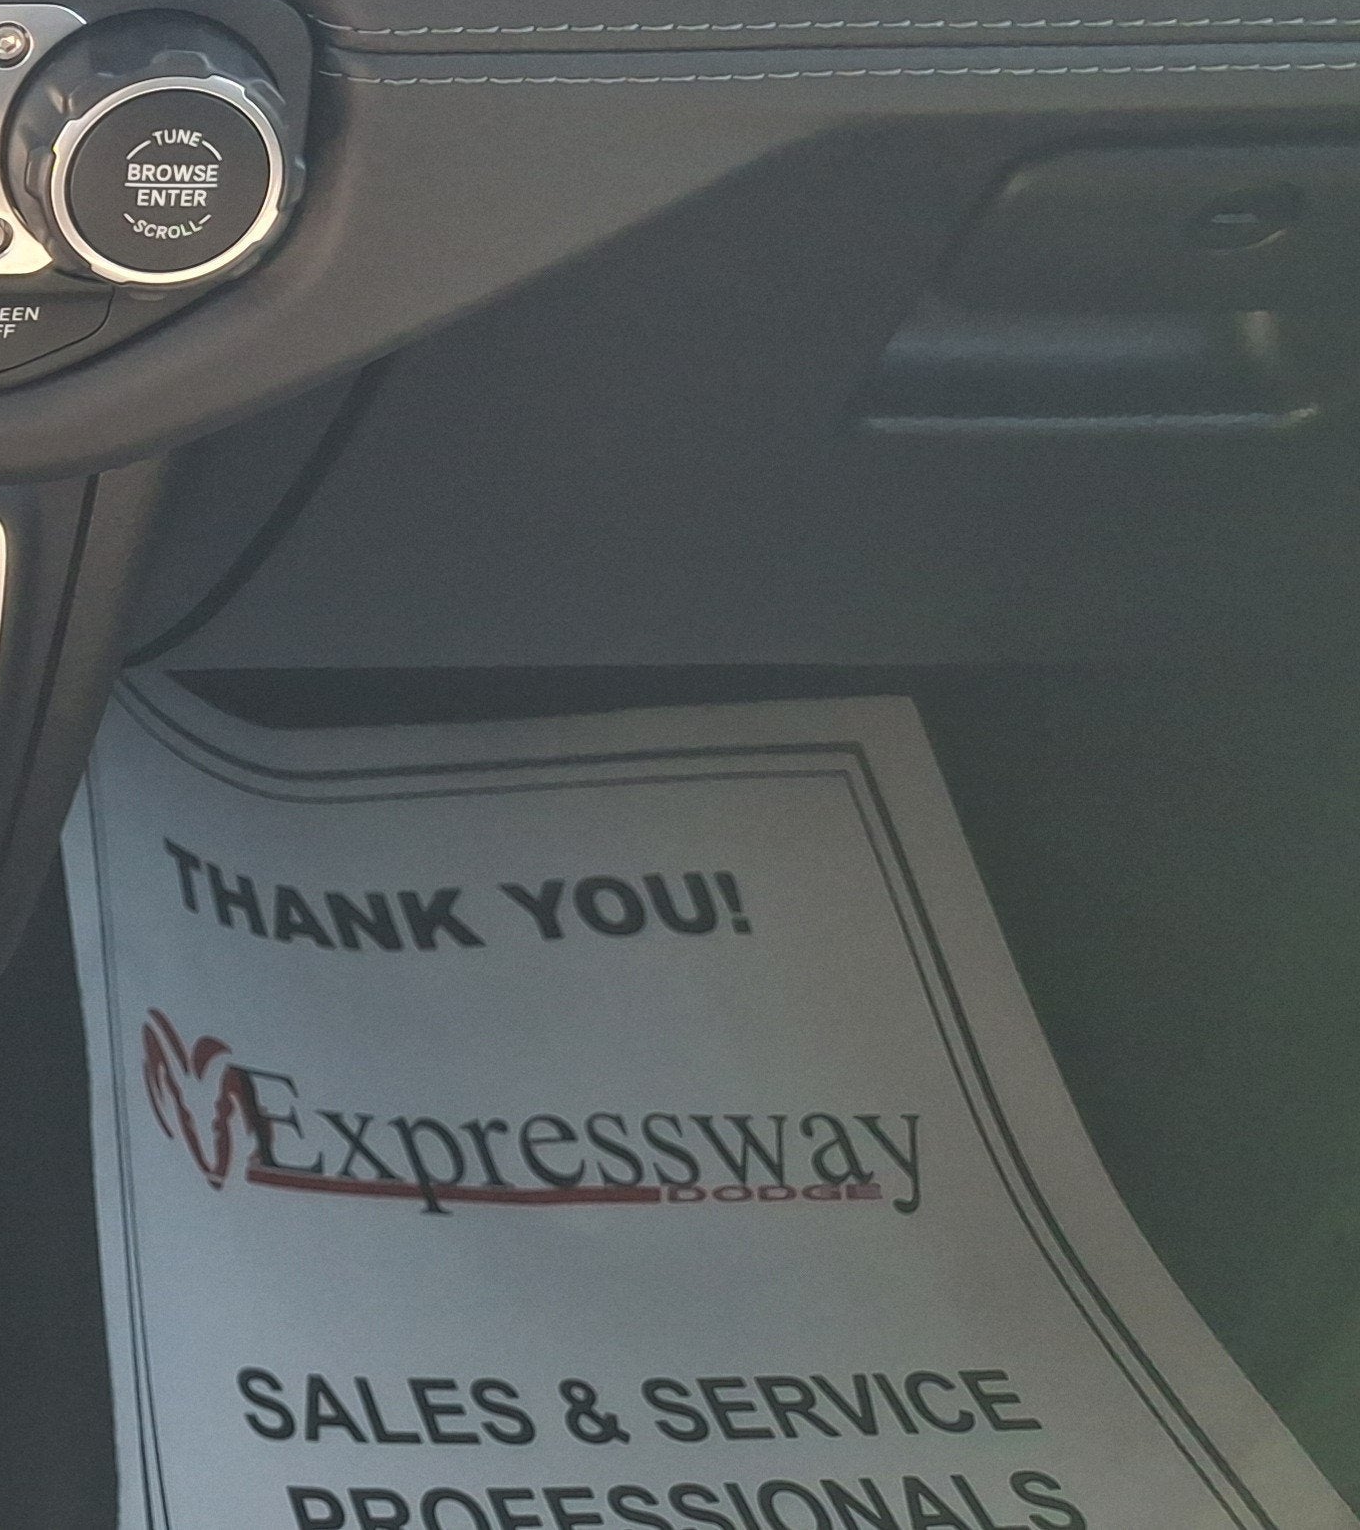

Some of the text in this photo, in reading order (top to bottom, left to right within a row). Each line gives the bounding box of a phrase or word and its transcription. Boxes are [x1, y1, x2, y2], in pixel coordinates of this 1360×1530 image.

[152, 128, 202, 148] TUNE
[126, 162, 218, 183] BROWSE
[136, 188, 207, 208] ENTER
[132, 217, 202, 240] SCROLL
[161, 835, 754, 952] THANK YOU!
[229, 1065, 921, 1215] Expressway
[664, 1181, 882, 1204] DODGE
[235, 1366, 1043, 1445] SALES & SERVICE
[285, 1470, 1082, 1530] PROFESSIONALS
